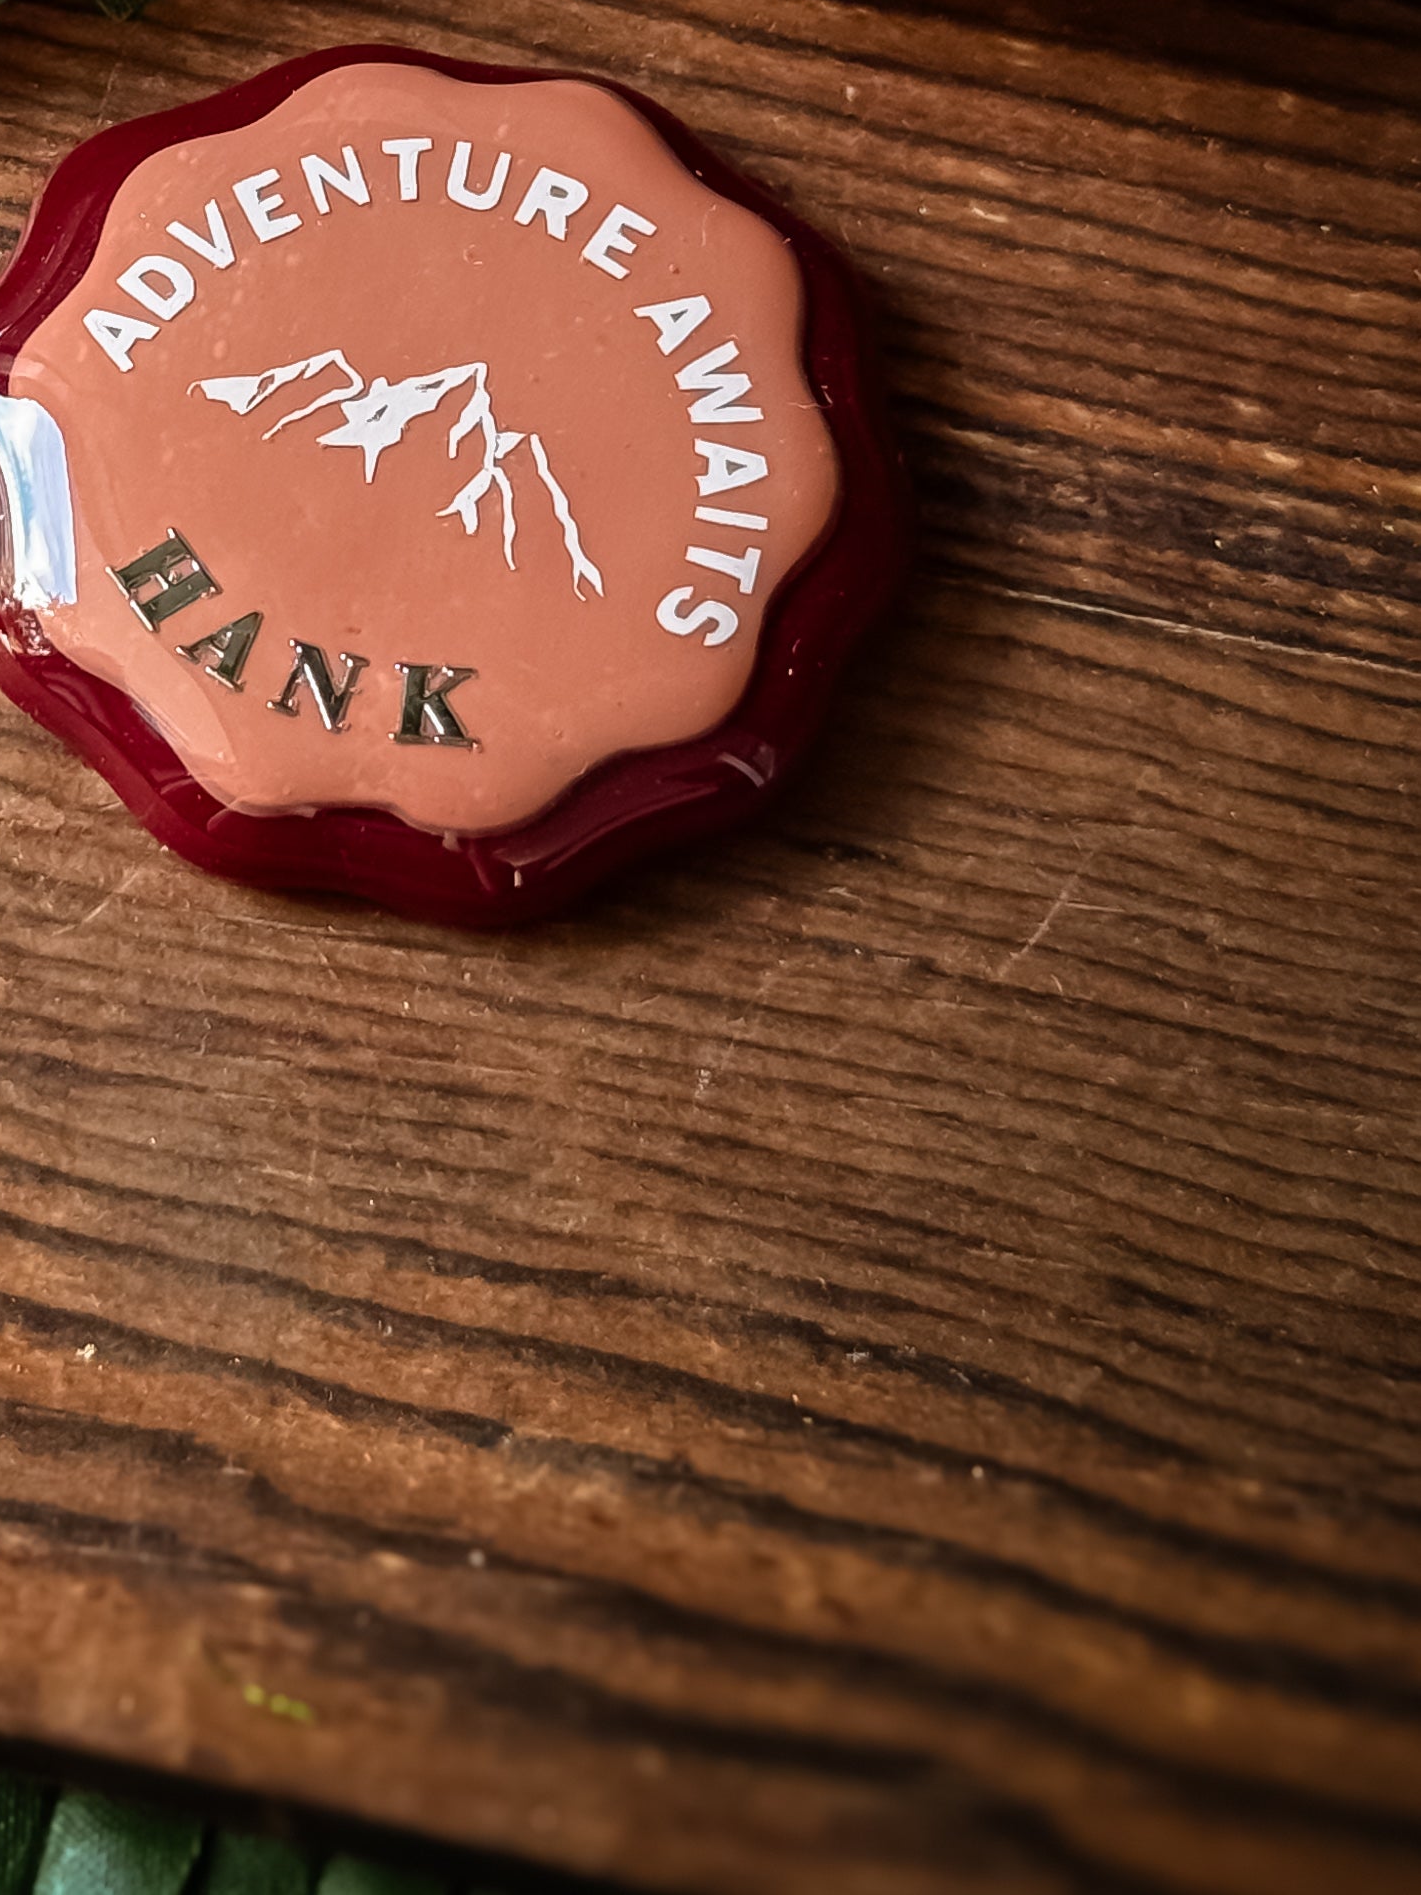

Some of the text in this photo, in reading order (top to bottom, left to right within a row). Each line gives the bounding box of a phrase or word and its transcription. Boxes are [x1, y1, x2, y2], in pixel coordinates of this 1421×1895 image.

[81, 136, 770, 649] ADVENTURE AWAITS
[105, 527, 481, 754] HANK
